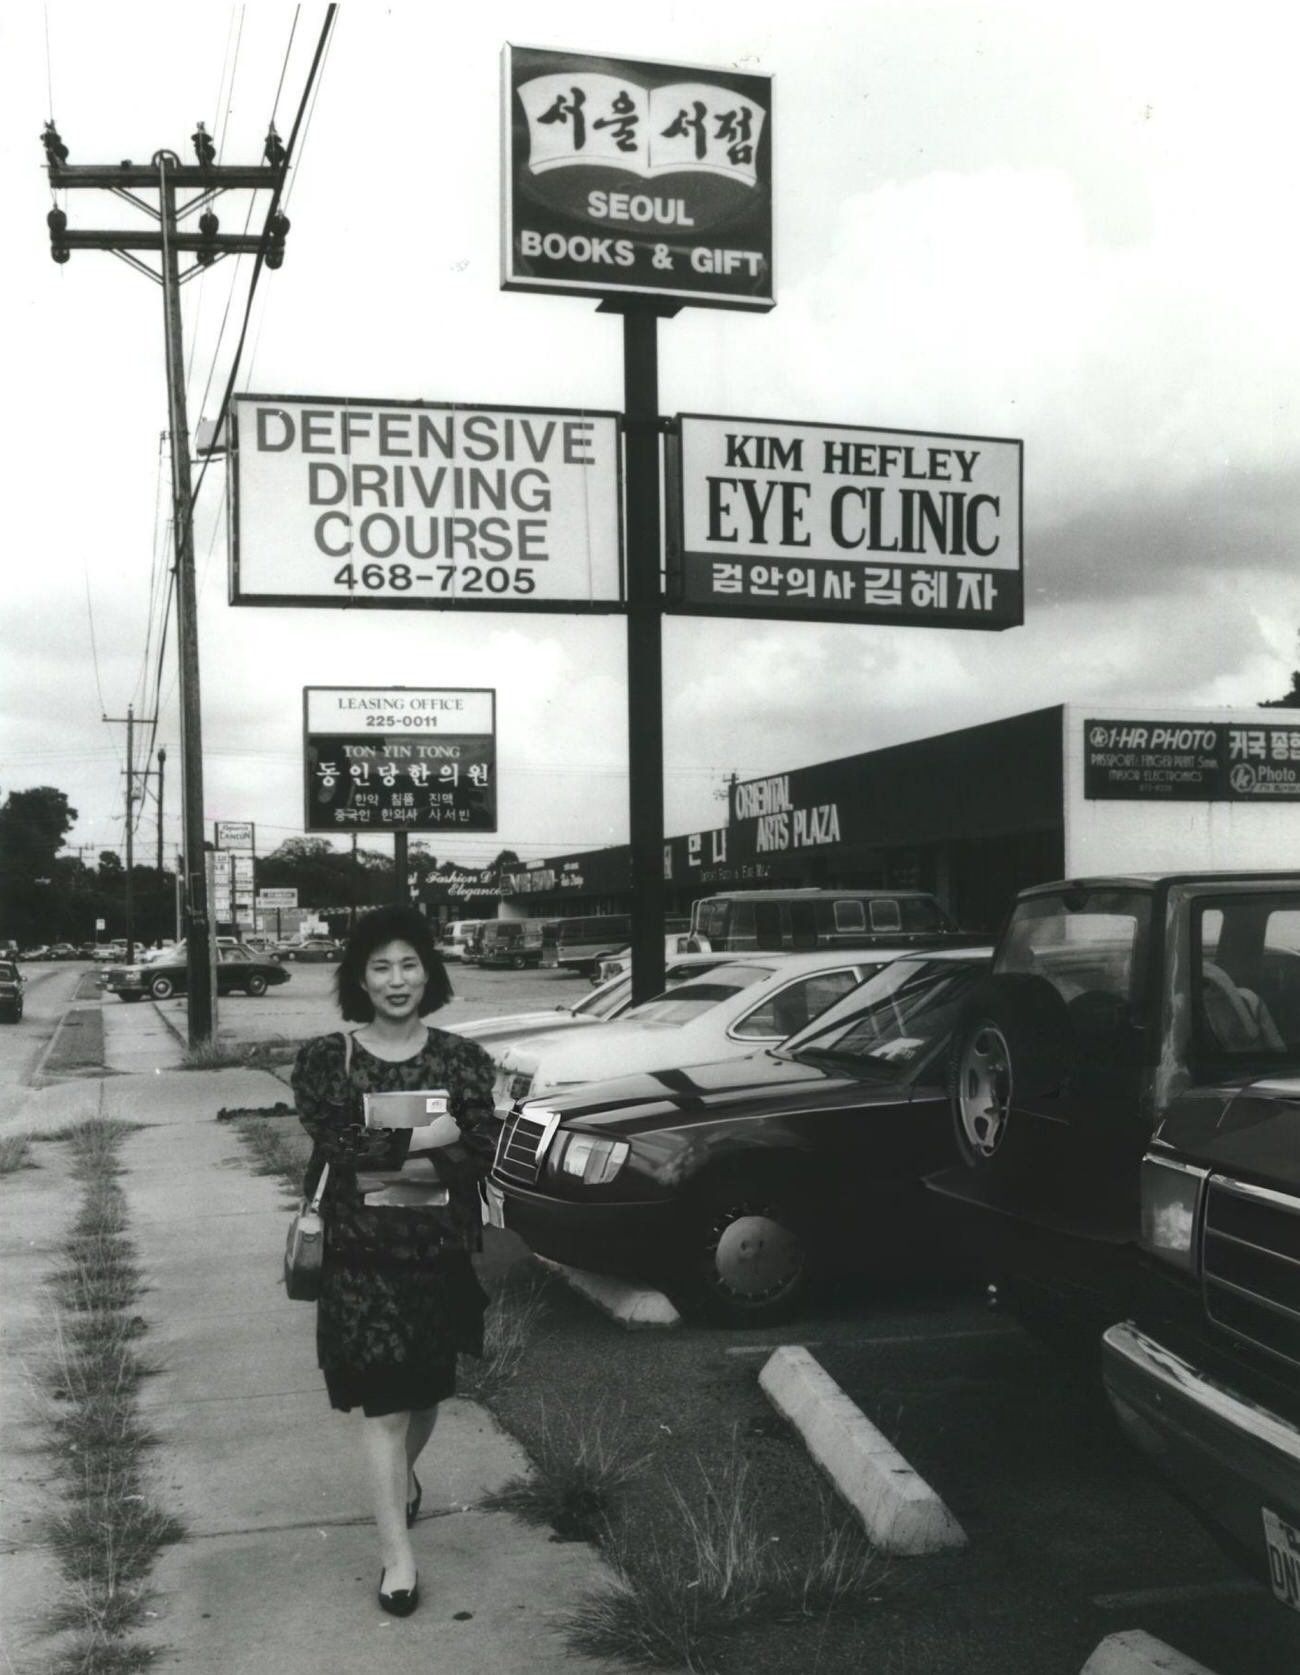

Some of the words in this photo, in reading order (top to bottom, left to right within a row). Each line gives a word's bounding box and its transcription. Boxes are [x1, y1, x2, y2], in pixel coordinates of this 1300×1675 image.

[537, 87, 639, 152] 서울
[659, 100, 752, 165] 서점
[587, 190, 694, 226] SEOUL
[520, 230, 635, 266] BOOKS
[652, 243, 673, 270] &
[690, 247, 764, 276] GIFT
[256, 407, 596, 465] DEFENSIVE
[725, 434, 804, 472] KIM
[822, 440, 981, 483] HEFLEY
[308, 462, 552, 512] DRIVING
[314, 510, 550, 561] COURSE
[706, 476, 811, 547] EYE
[830, 485, 1000, 557] CLINIC
[333, 563, 536, 594] 468-7205
[864, 567, 998, 611] 김혜자
[338, 697, 405, 710] LEASING
[410, 698, 464, 711] OFFICE
[366, 715, 438, 728] 225-0011
[342, 745, 376, 758] TON
[382, 745, 412, 758] YIN
[416, 745, 461, 758] TONG
[1108, 727, 1149, 748] 1-HR
[1150, 729, 1217, 750] PHOTO
[1258, 765, 1296, 782] Photo
[735, 775, 793, 821] ORIENTAL
[756, 812, 788, 853] ARTS
[793, 803, 841, 848] PLAZA
[425, 870, 478, 884] Fashion
